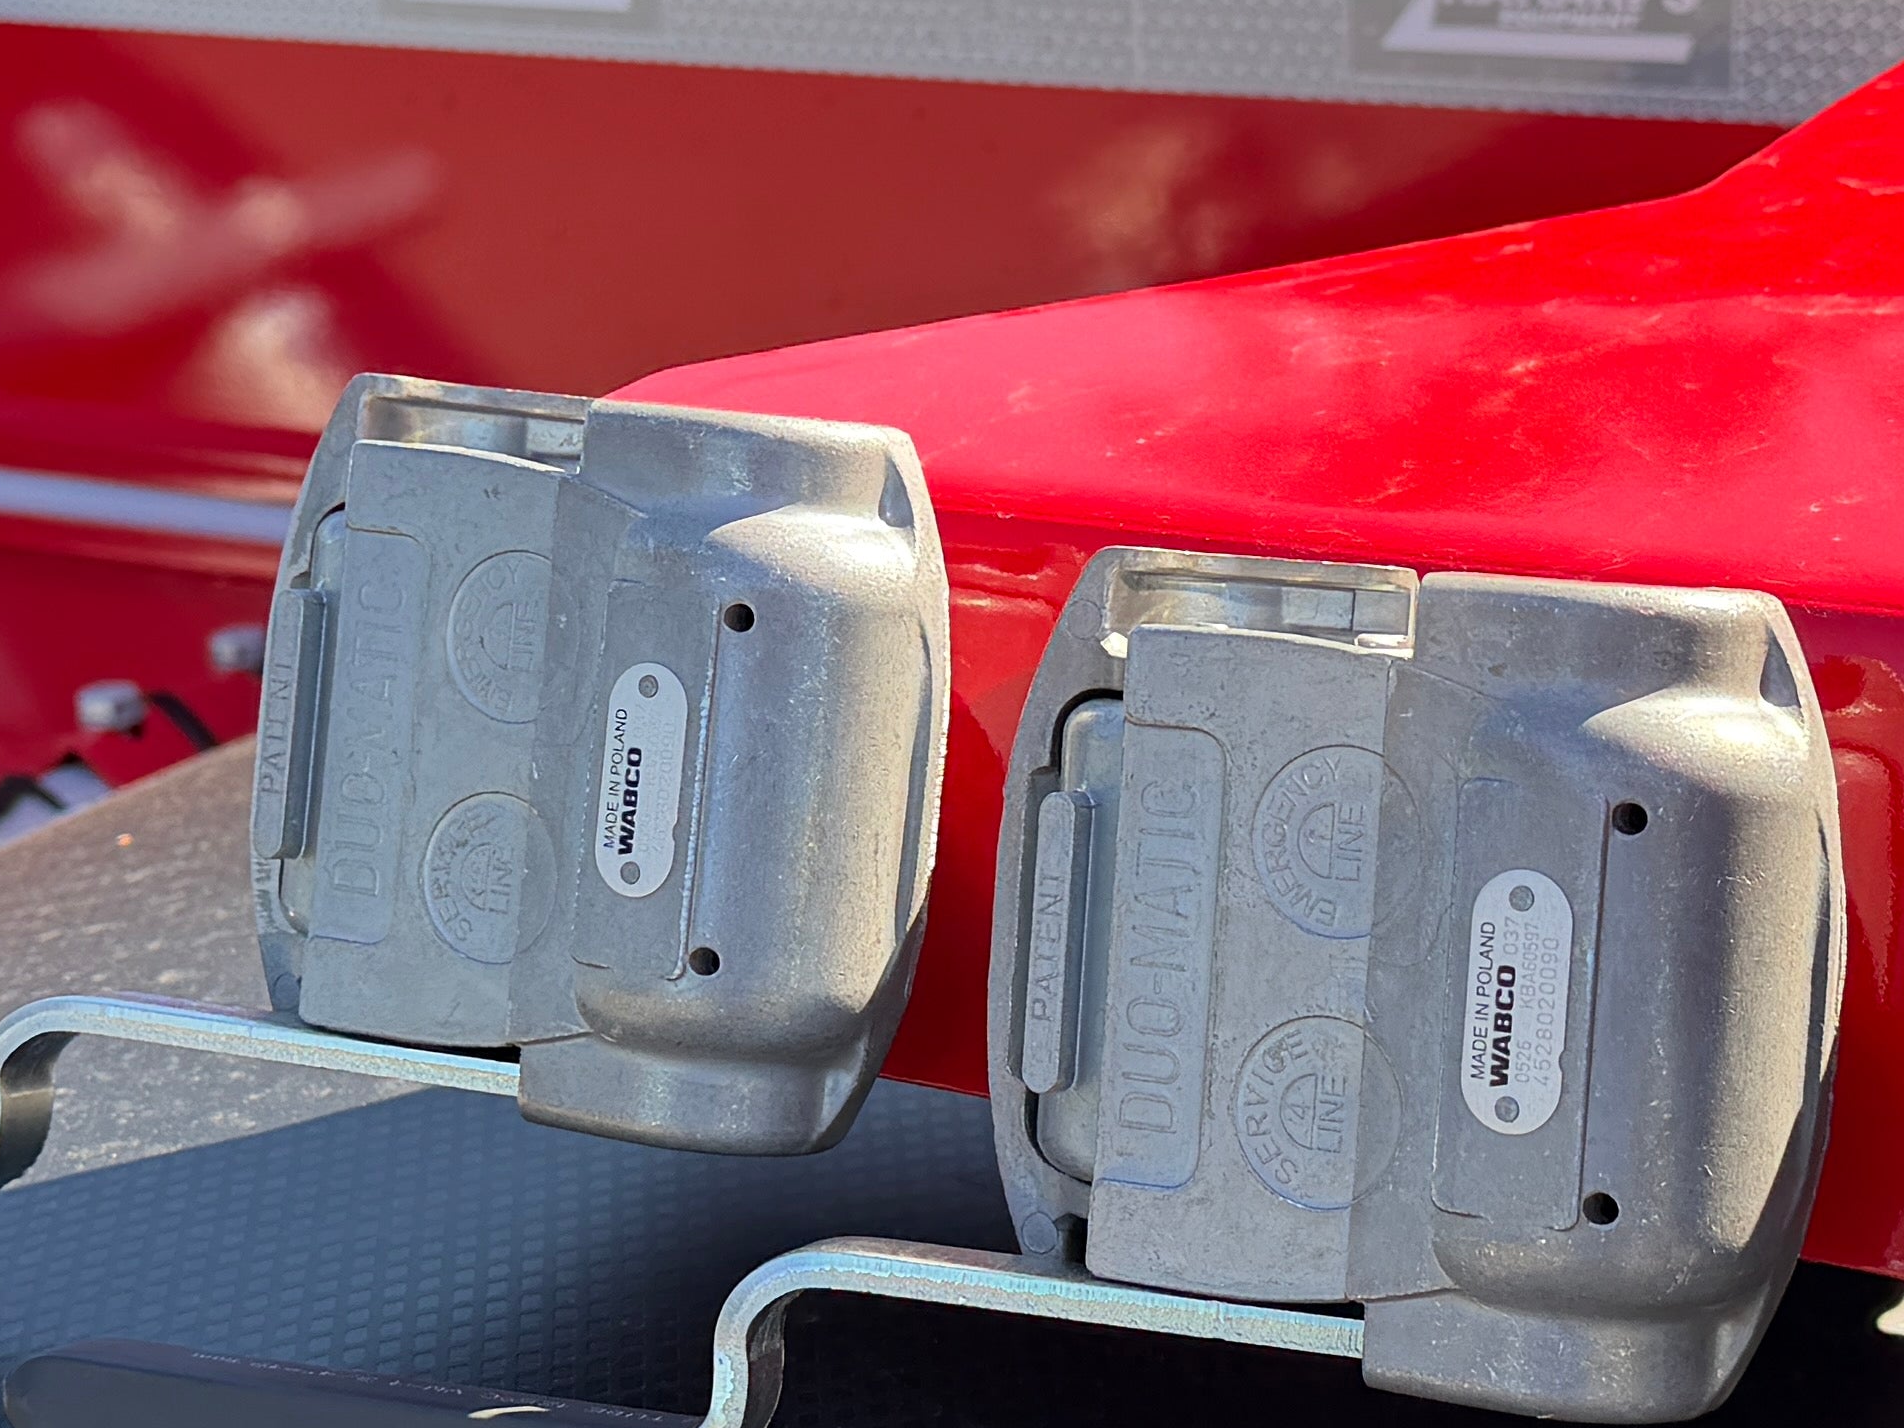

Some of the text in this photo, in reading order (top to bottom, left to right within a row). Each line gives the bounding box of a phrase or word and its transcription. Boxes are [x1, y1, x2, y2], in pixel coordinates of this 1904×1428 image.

[603, 708, 628, 849] MADE IN POLAND
[617, 747, 643, 856] WABCO
[1264, 755, 1342, 926] EMERGENCY
[1335, 803, 1366, 883] LINE
[1029, 871, 1067, 1022] PATENT
[1117, 778, 1205, 1135] DUO-MATIC
[1470, 921, 1496, 1080] MADE IN POLAND
[1489, 916, 1519, 1087] WABCO 037
[1243, 1029, 1308, 1184] SERVICE
[1316, 1074, 1348, 1154] LINE
[1515, 1040, 1532, 1083] 0526
